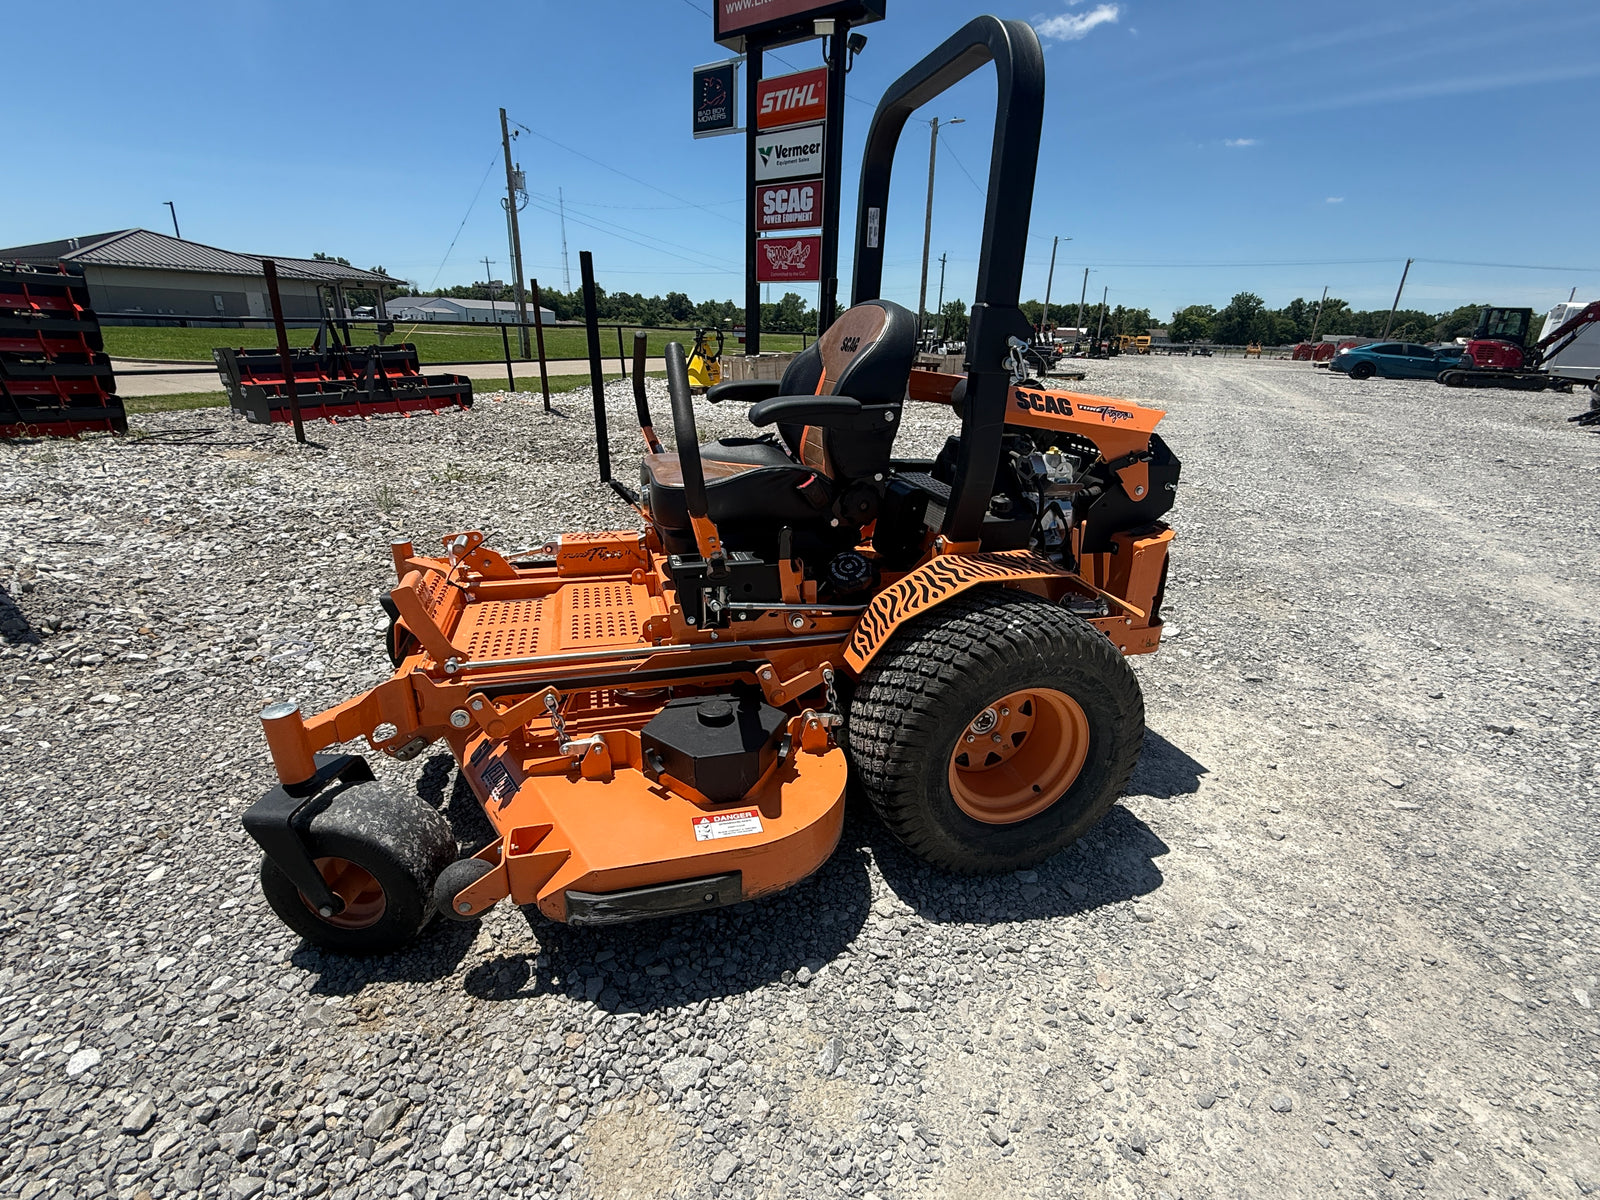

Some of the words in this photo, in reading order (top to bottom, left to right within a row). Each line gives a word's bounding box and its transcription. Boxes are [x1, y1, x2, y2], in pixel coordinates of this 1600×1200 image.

[697, 113, 727, 123] MOWERS
[775, 143, 821, 159] Vermeer
[763, 186, 813, 214] SCAG
[763, 214, 782, 224] POWER
[782, 211, 813, 223] EQUIPMENT
[840, 336, 860, 352] SCAG
[1015, 391, 1074, 417] SCAG
[713, 812, 752, 822] DANGER
